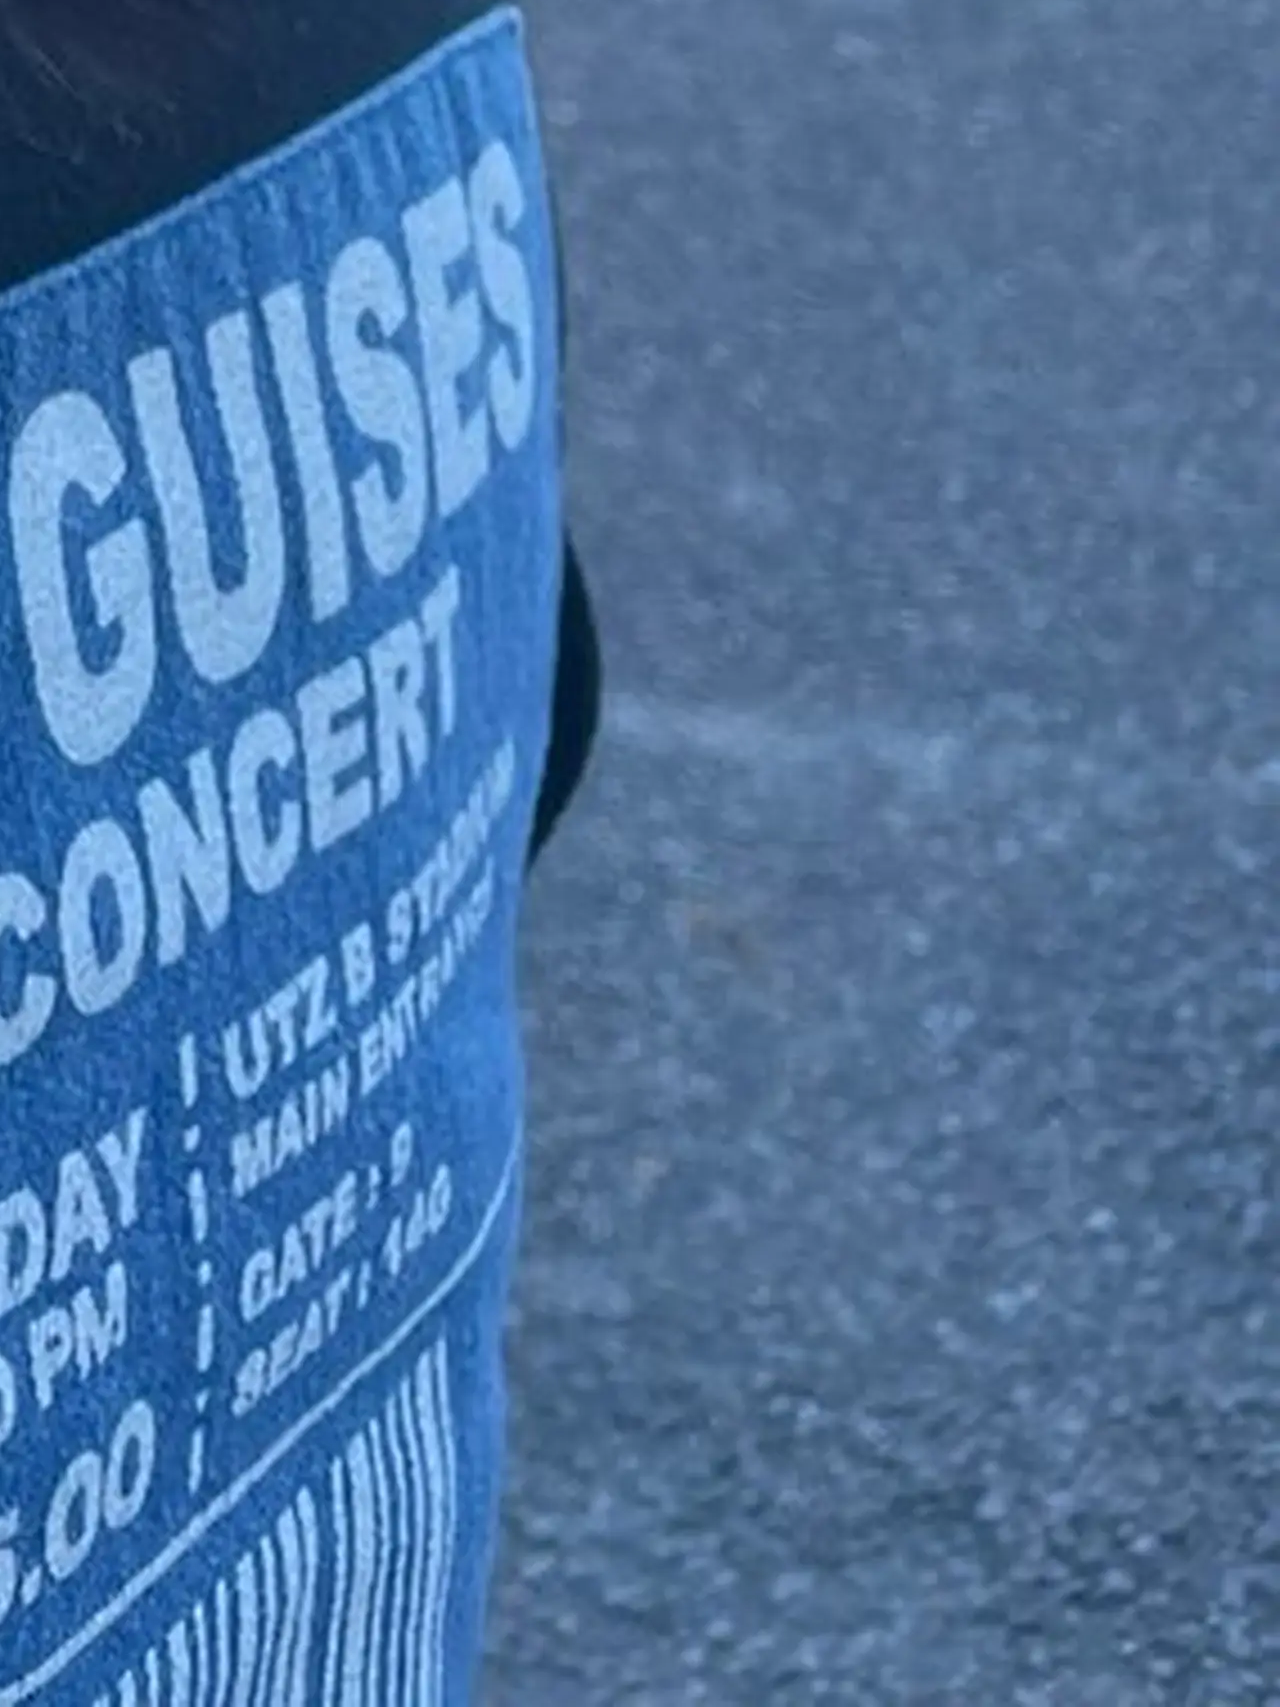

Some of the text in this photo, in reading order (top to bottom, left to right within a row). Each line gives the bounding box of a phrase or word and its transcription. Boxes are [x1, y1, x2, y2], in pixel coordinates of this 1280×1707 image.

[8, 140, 534, 765] GUISES
[222, 954, 337, 1098] UTZ
[230, 1053, 349, 1197] MAIN
[242, 1170, 358, 1322] GATE
[29, 1261, 127, 1410] PM
[231, 1270, 351, 1416] SEAT
